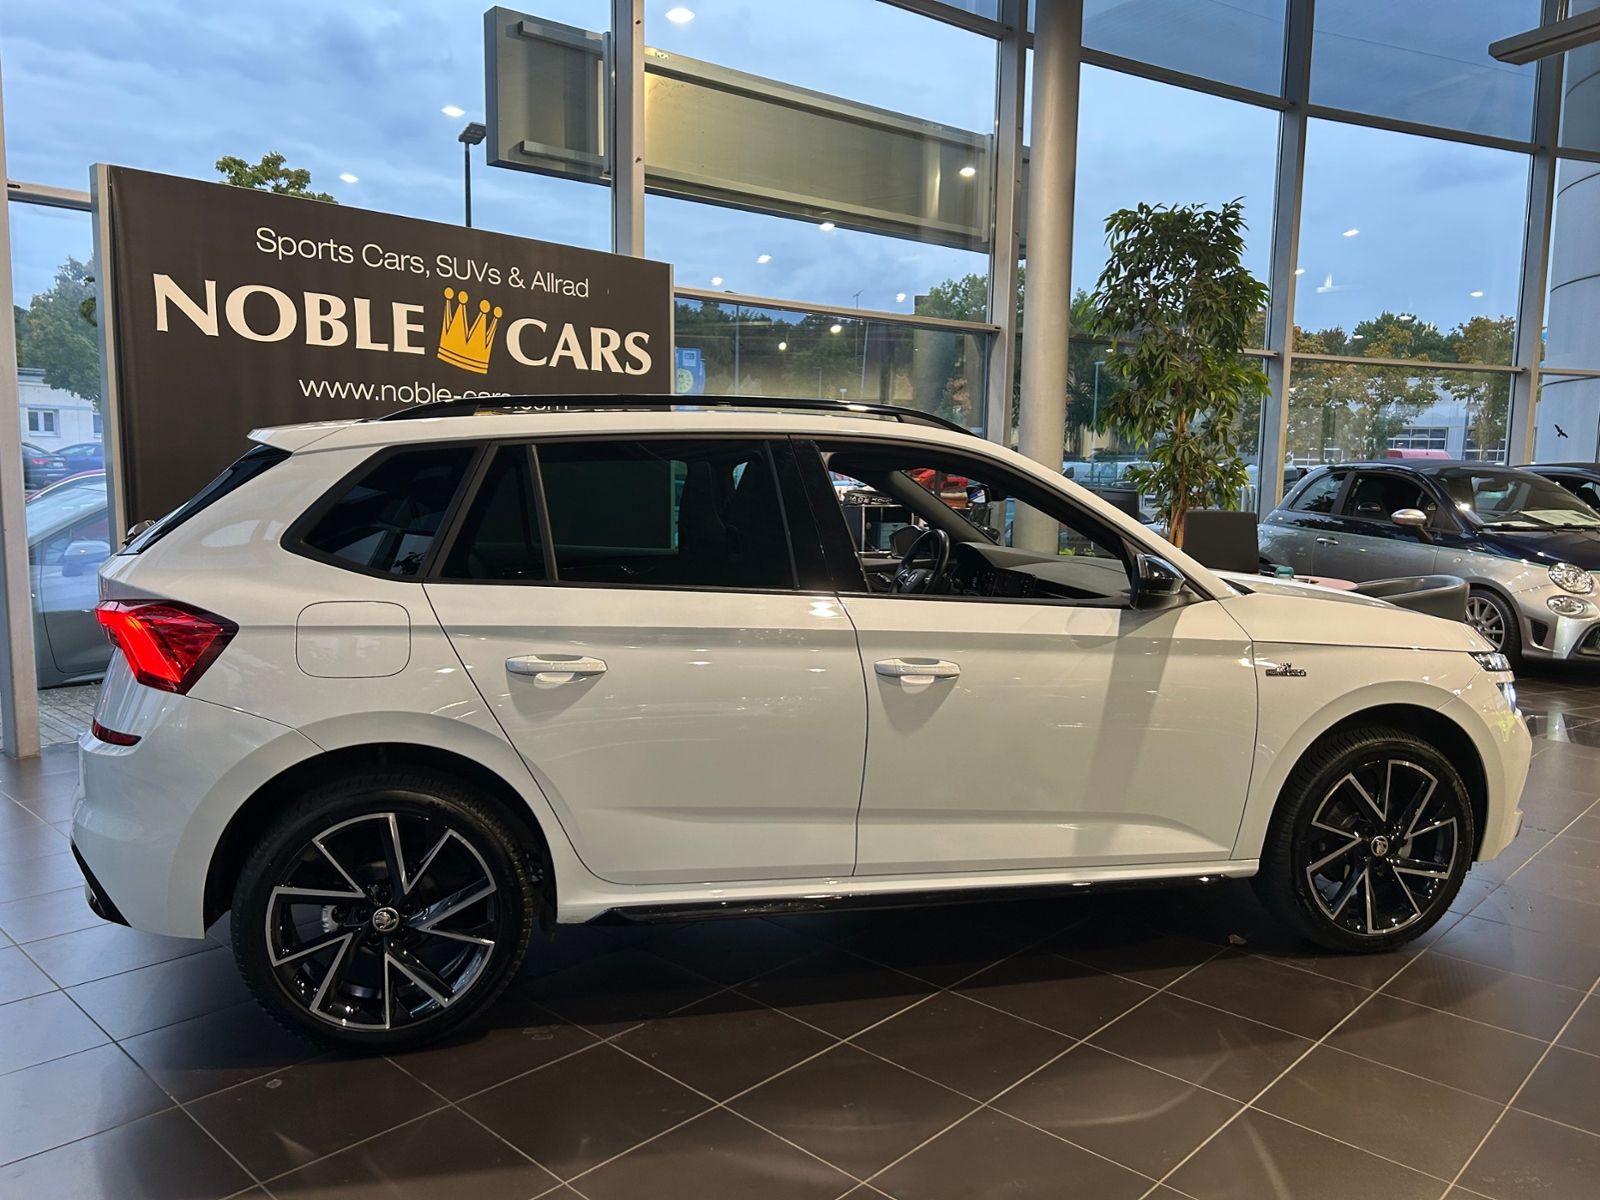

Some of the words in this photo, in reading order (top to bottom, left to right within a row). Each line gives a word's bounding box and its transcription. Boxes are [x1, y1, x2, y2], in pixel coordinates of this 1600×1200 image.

[256, 227, 354, 264] Sports
[362, 244, 431, 278] Cars,
[436, 254, 502, 285] SUVs
[508, 267, 526, 289] &
[531, 271, 589, 298] Allrad
[153, 273, 425, 355] NOBLE
[506, 318, 652, 376] CARS
[298, 379, 568, 410] www.noble-.
